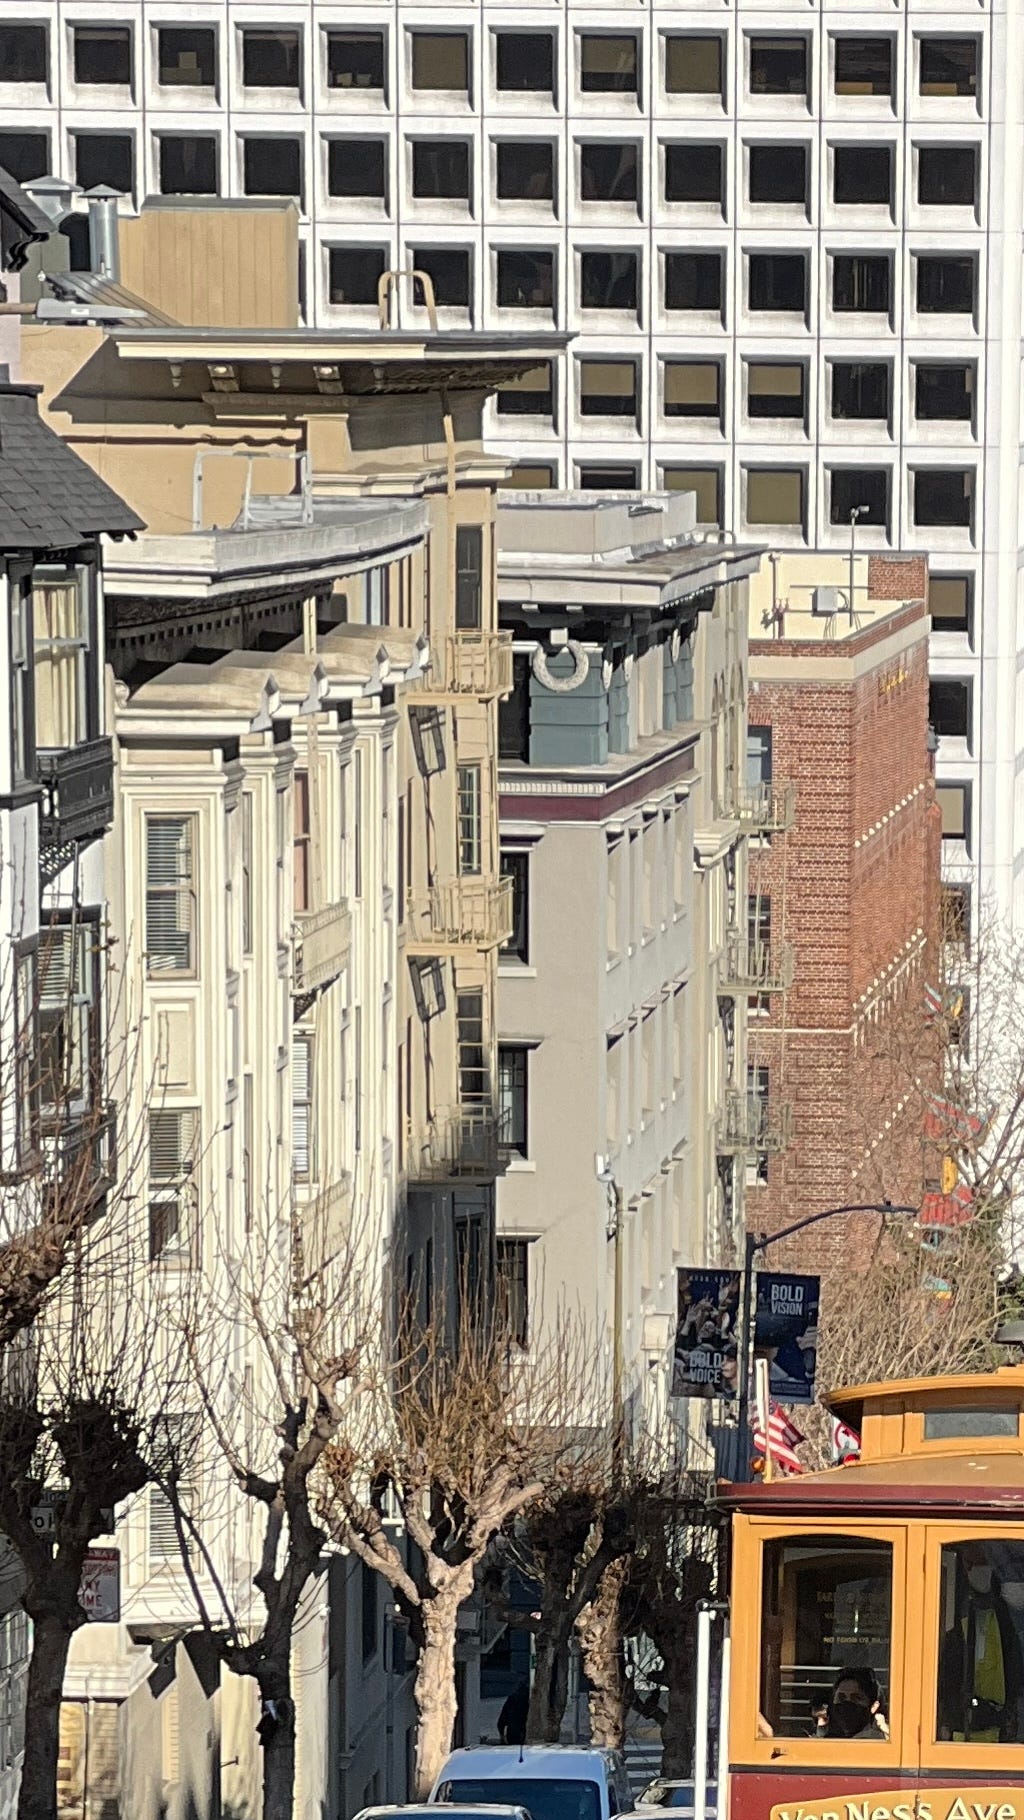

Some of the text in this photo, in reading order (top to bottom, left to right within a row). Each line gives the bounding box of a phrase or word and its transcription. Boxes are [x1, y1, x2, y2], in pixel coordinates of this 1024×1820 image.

[772, 1284, 804, 1302] BOLD
[690, 1351, 722, 1369] BOLD
[690, 1368, 721, 1383] VOICE
